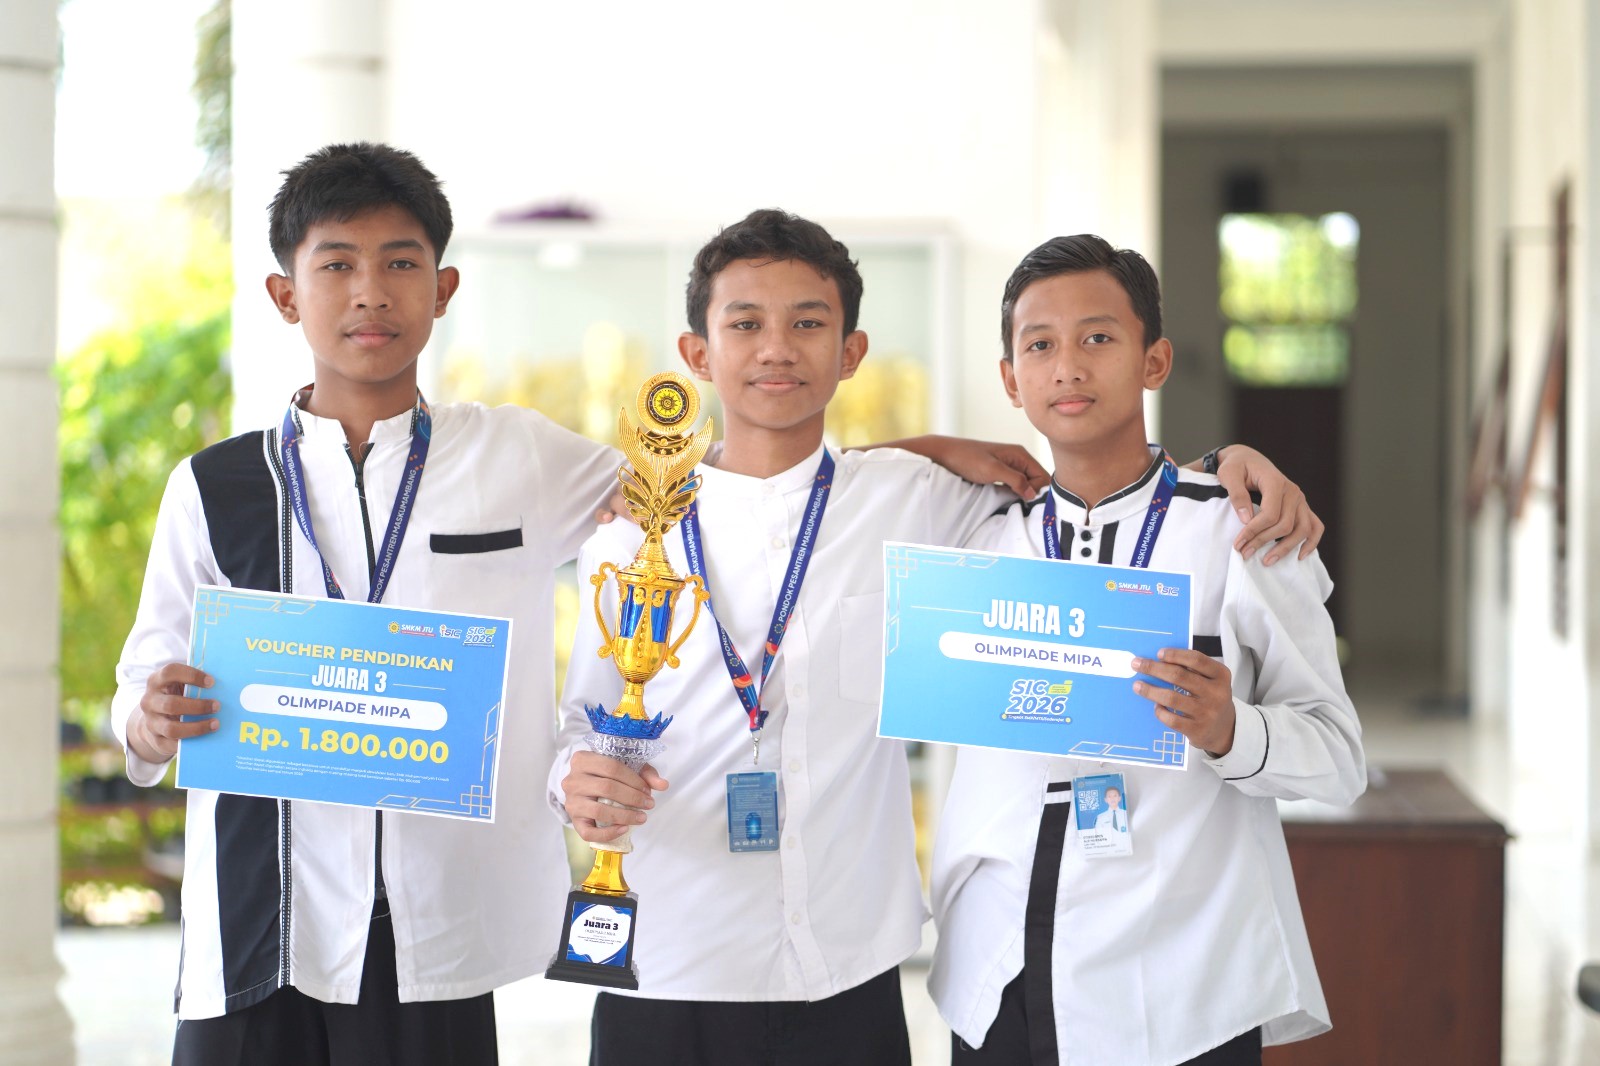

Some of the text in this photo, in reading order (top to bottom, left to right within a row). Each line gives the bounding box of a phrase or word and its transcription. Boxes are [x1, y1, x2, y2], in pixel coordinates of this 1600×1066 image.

[285, 447, 302, 507] MASKUMAMBANG
[380, 533, 398, 578] PESANTREN
[393, 469, 417, 535] MASKUMAMBANG
[685, 519, 700, 575] ASKUMAMBANG
[778, 487, 825, 623] PONDOK PESANTREN MASKUMAMBANG
[982, 598, 1085, 638] JUARA 3
[245, 637, 454, 672] VOUCHER PENDIDIKAN
[464, 634, 493, 643] 2026
[974, 642, 1103, 668] OLIMPIADE MIPA
[311, 664, 388, 693] JUARA 3
[1010, 679, 1049, 697] SIC
[277, 694, 411, 720] OLIMPIADE MIPA
[1005, 695, 1069, 715] 2026
[239, 721, 449, 764] Rp. 1.800.000
[584, 919, 611, 929] Juara
